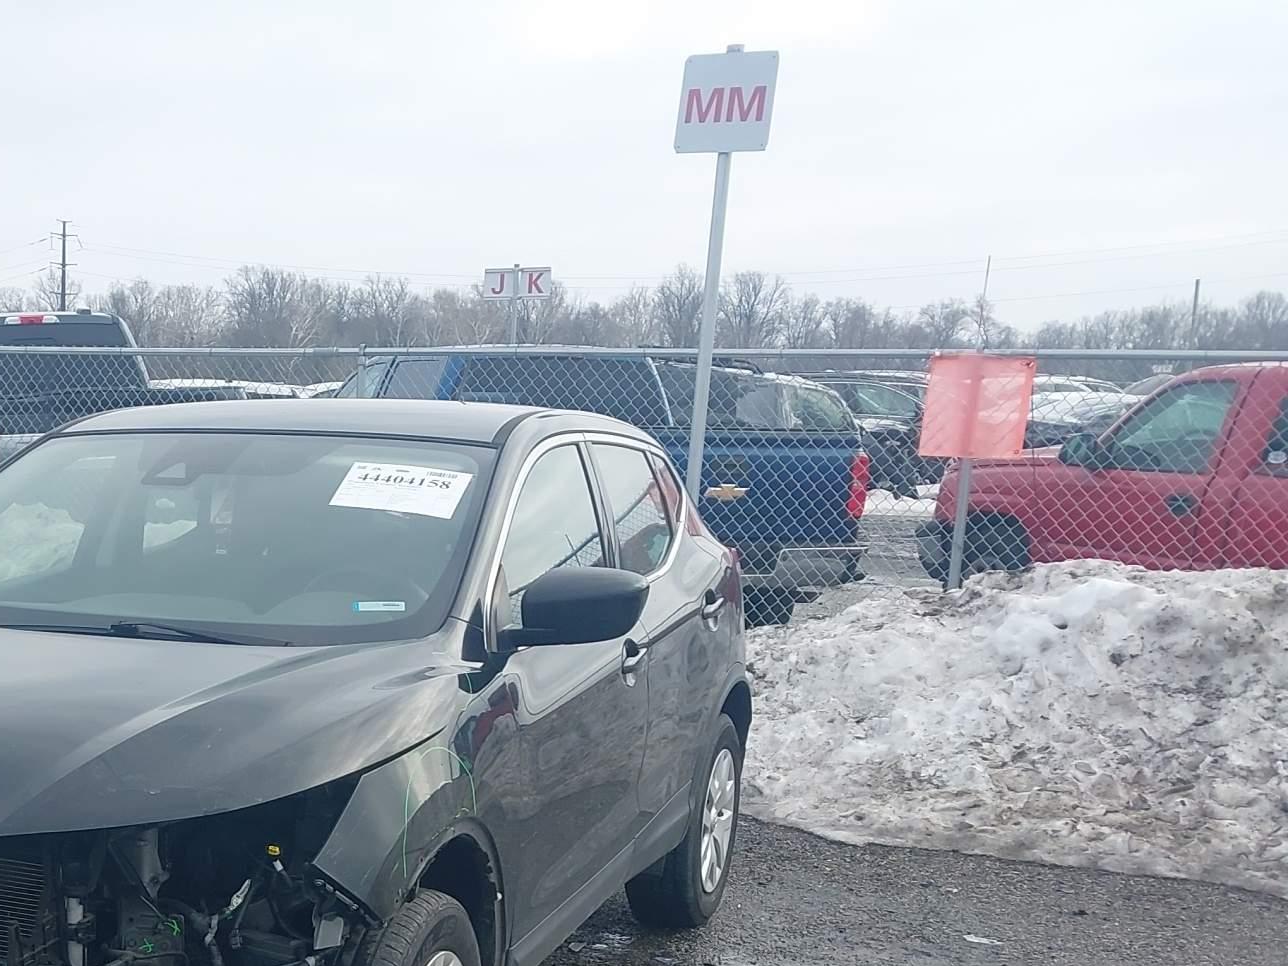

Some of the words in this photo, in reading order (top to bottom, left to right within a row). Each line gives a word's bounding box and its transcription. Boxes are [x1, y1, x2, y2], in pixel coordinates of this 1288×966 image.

[684, 85, 767, 124] MM
[491, 272, 505, 295] J
[527, 272, 545, 294] K
[357, 472, 452, 490] 44404158
